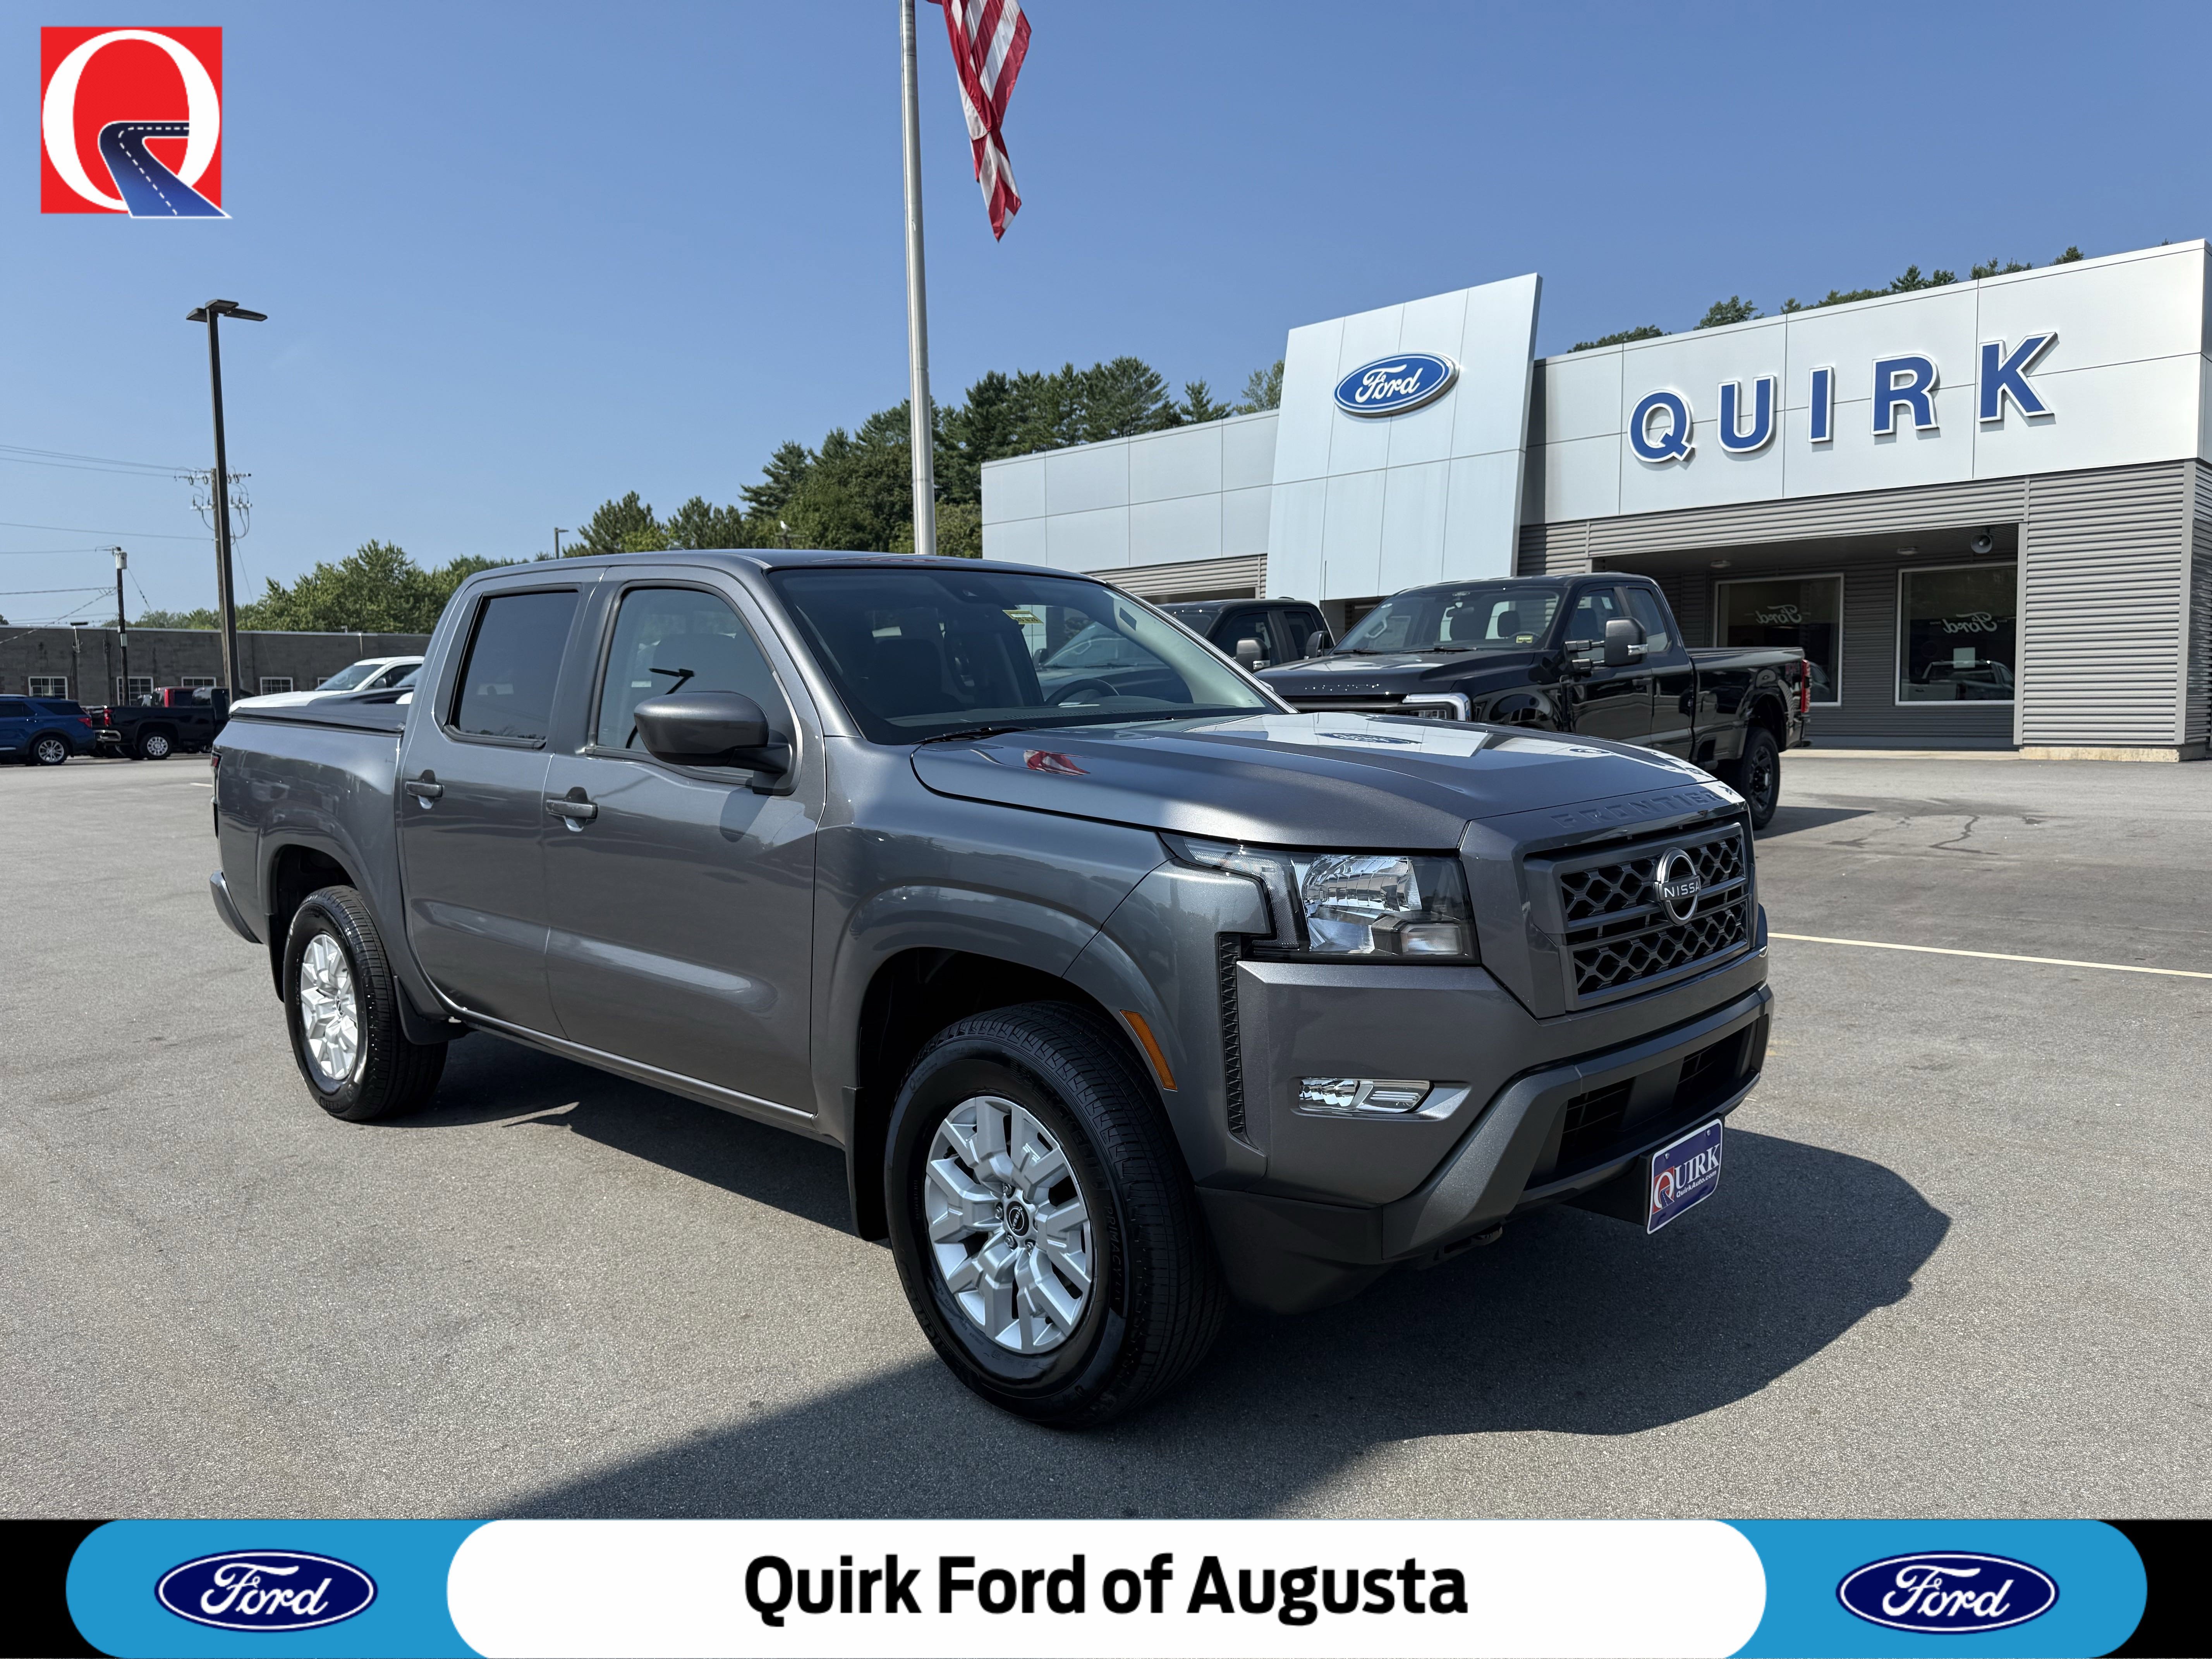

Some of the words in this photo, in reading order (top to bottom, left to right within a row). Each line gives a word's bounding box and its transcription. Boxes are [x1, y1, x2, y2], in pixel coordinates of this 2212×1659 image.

[1355, 364, 1424, 403] Ford
[1628, 333, 2056, 463] QUIRK
[1550, 790, 1724, 828] FRONTIER
[1654, 1143, 1720, 1209] QUIRK
[1676, 1170, 1717, 1198] QuirkAuto.com
